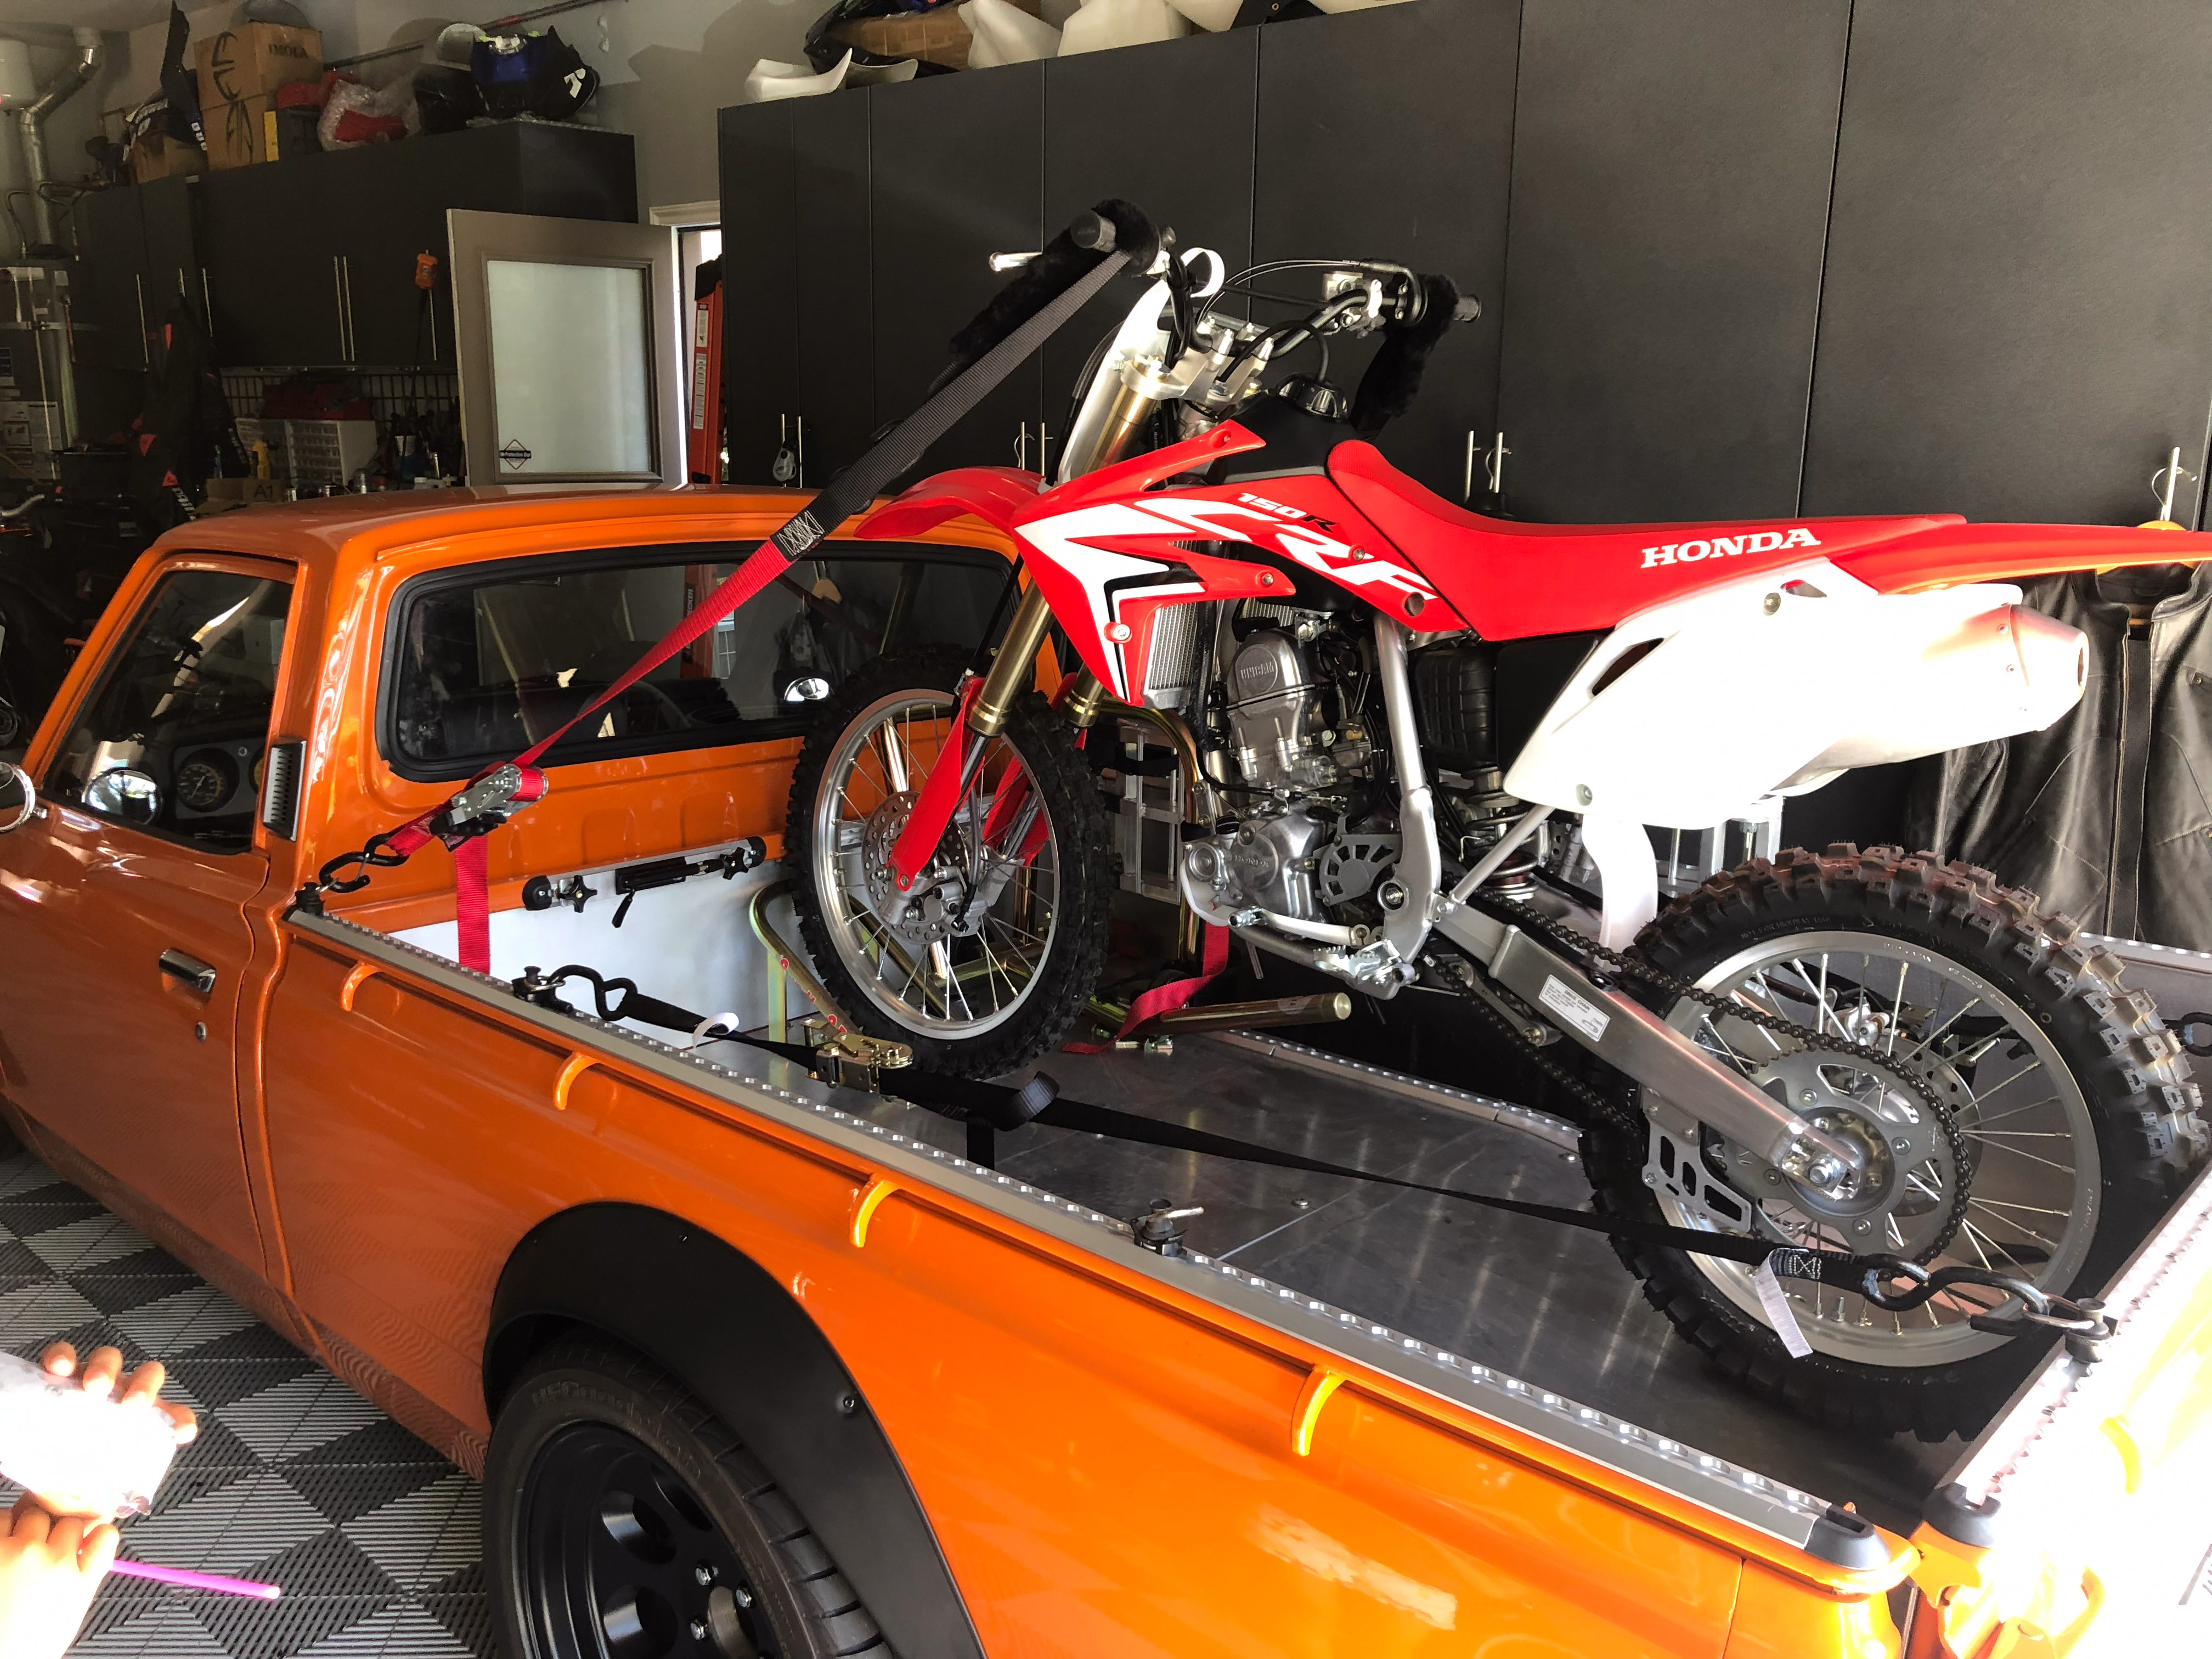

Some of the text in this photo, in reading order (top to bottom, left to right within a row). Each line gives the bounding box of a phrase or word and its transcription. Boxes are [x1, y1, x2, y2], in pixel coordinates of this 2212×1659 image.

[1236, 492, 1339, 533] 150R
[1640, 528, 1821, 569] HONDA
[1240, 661, 1274, 680] UNICAM
